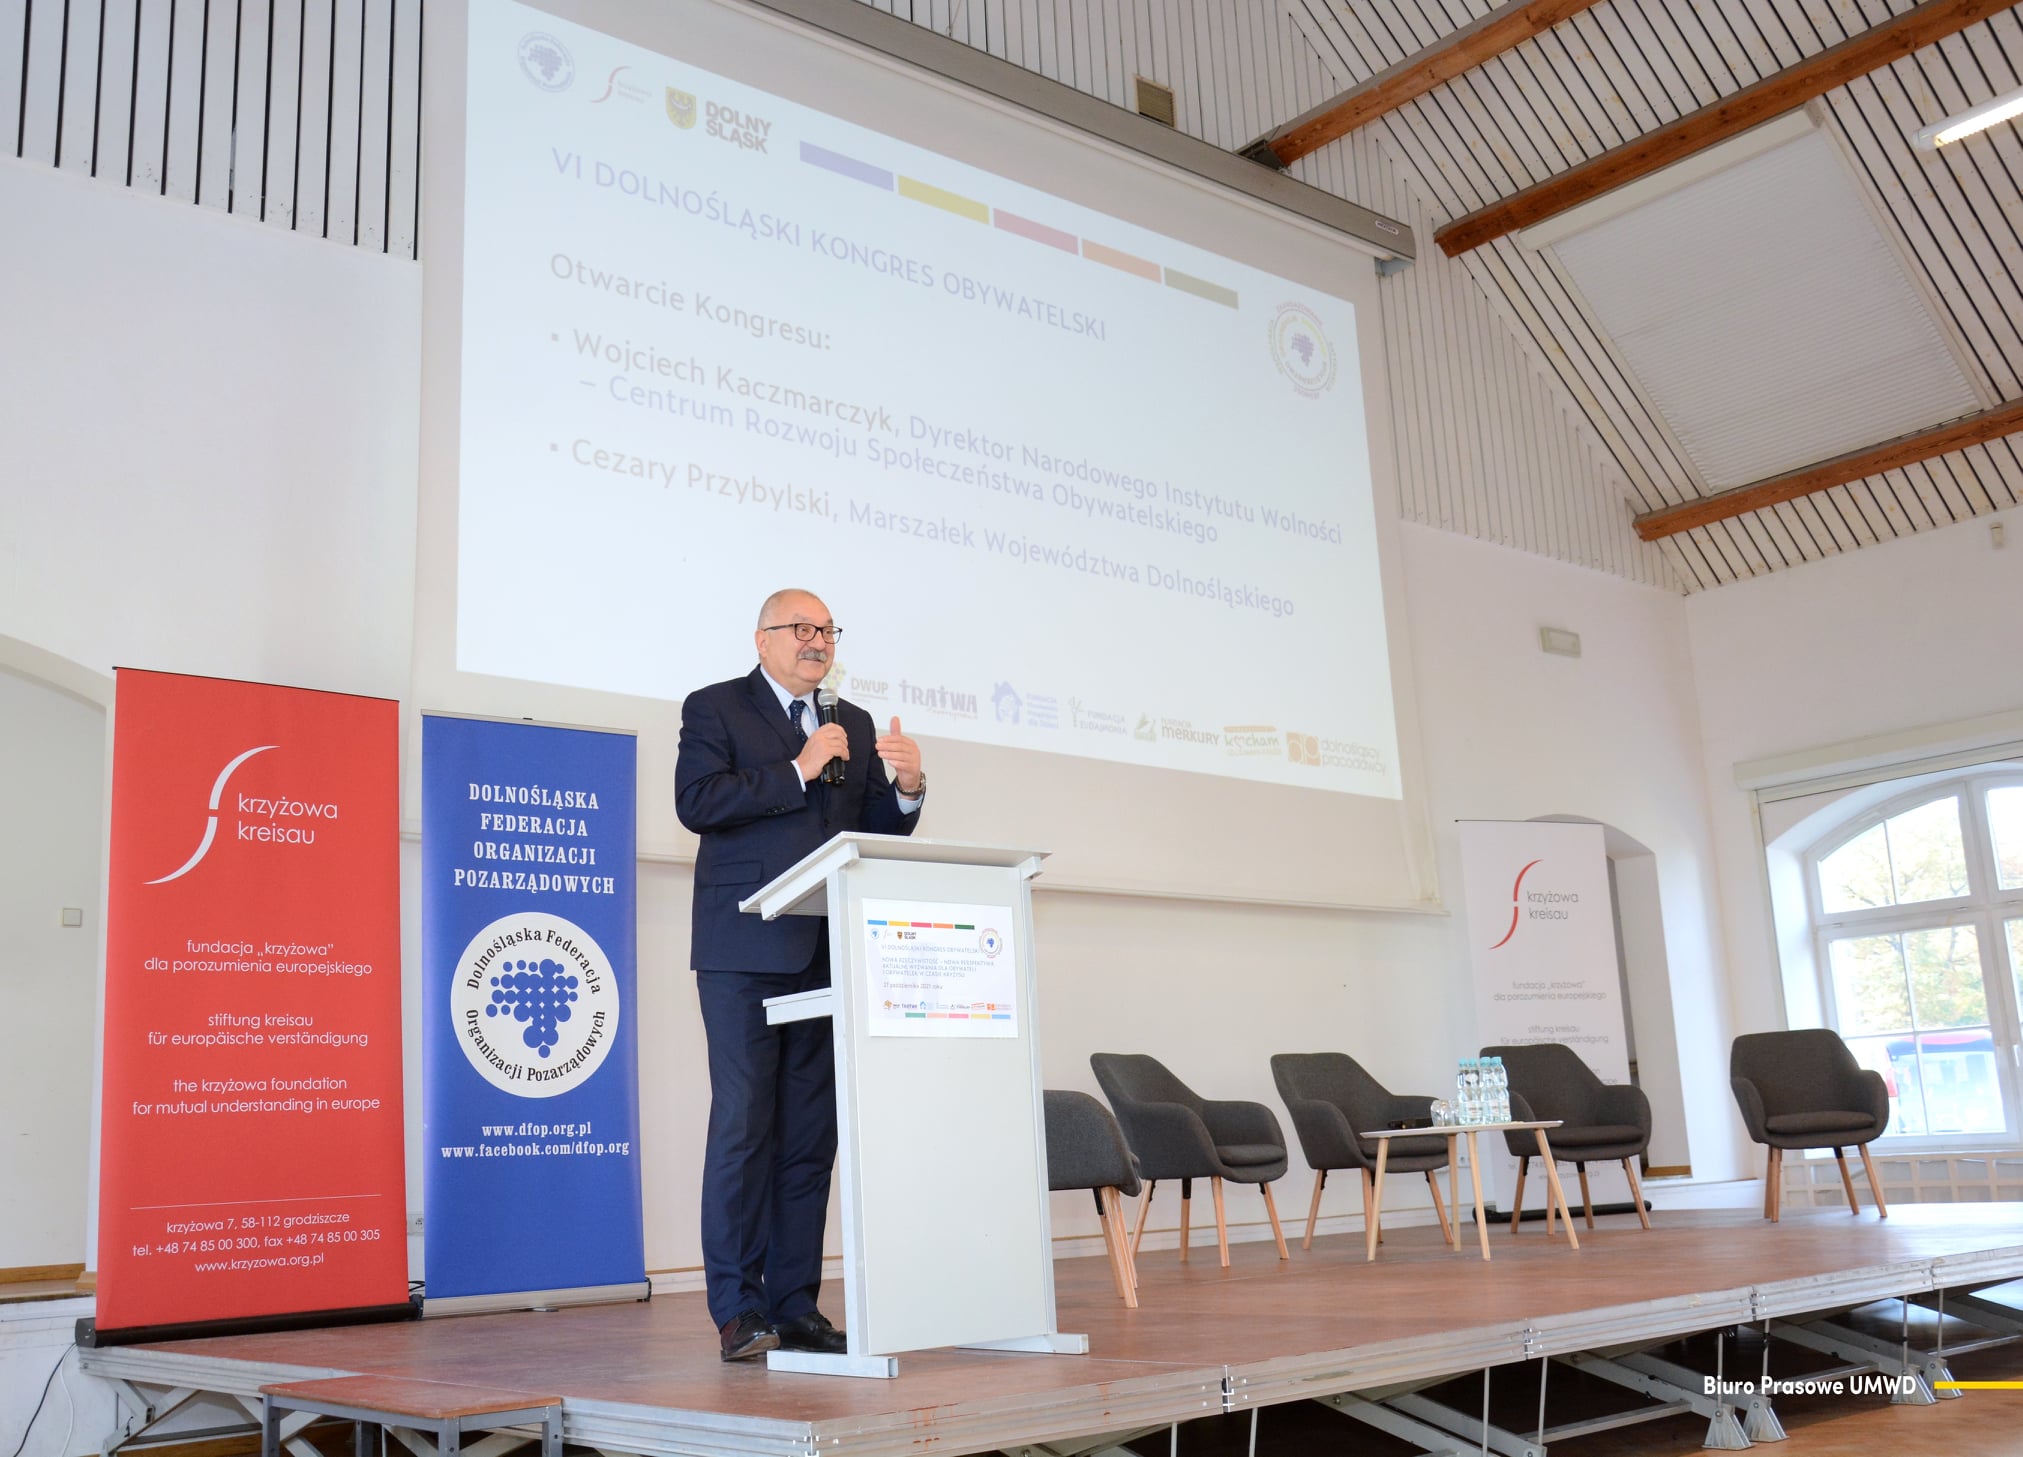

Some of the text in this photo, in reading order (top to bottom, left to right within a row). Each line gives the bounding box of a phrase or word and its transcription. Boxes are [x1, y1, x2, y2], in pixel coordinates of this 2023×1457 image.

[705, 100, 772, 137] DOLNY
[551, 146, 1107, 342] VI DOLNOŚLĄSKI KONGRES OBYWATELSKI
[550, 252, 832, 351] Otwarcie Kongresu:
[573, 328, 1343, 545] Wojciech Kaczmarczyk, Dyrektor Narodowego Instytutu Wolności
[608, 375, 1218, 544] Centrum Rozwoju Społeczeństwa Obywatelskiego
[570, 438, 1295, 618] Cezary Przybylski, Marszałek Województwa Dolnośląskiego
[850, 677, 889, 695] DWUP
[237, 792, 339, 819] krzyżowa
[469, 783, 600, 810] DOLNOŚLĄSKA
[237, 820, 315, 845] kreisau
[480, 812, 589, 837] FEDERACJA
[473, 841, 596, 865] ORGANIZACJI
[453, 868, 616, 895] POZARZĄDOWYCH
[1526, 890, 1580, 904] krzyżowa
[1528, 907, 1569, 920] kreisau
[186, 939, 254, 957] fundacja
[144, 957, 373, 977] dla porozumienia europejskiego
[466, 927, 602, 995] Dolnośląska Federacja
[207, 1013, 313, 1029] stiftung kreisau
[148, 1031, 368, 1048] für europäische verständigung
[465, 1009, 606, 1082] Organizacji Pozarządowych
[173, 1077, 347, 1094] the krzyżowa foundation
[133, 1097, 381, 1115] for mutual understanding in europe
[481, 1121, 592, 1138] www.dfop.org.pl
[441, 1141, 630, 1159] www.facebook.com/dfop.org
[166, 1212, 350, 1235] krzyżowa 7, 58-112 grodziszcze
[132, 1229, 381, 1257] tel. +48 74 85 00 300, fax +48 74 85 00 305
[194, 1252, 325, 1273] www.krzyzowa.org.pl
